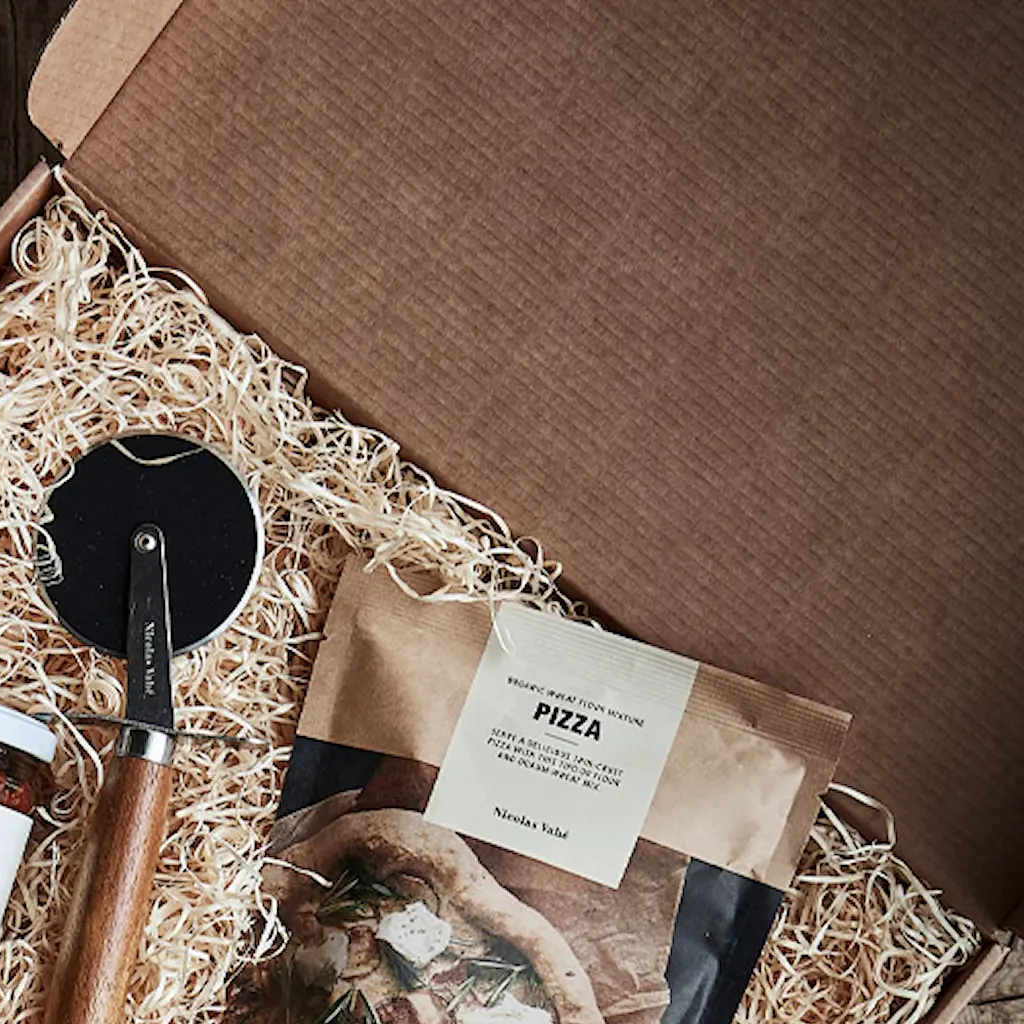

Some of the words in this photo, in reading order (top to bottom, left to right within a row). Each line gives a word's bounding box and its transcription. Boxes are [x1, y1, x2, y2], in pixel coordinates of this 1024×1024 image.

[144, 621, 155, 665] Nicolas
[533, 702, 602, 741] PIZZA
[487, 737, 511, 753] PIZZA
[493, 806, 537, 829] Nicolas
[541, 822, 569, 839] Vahé
